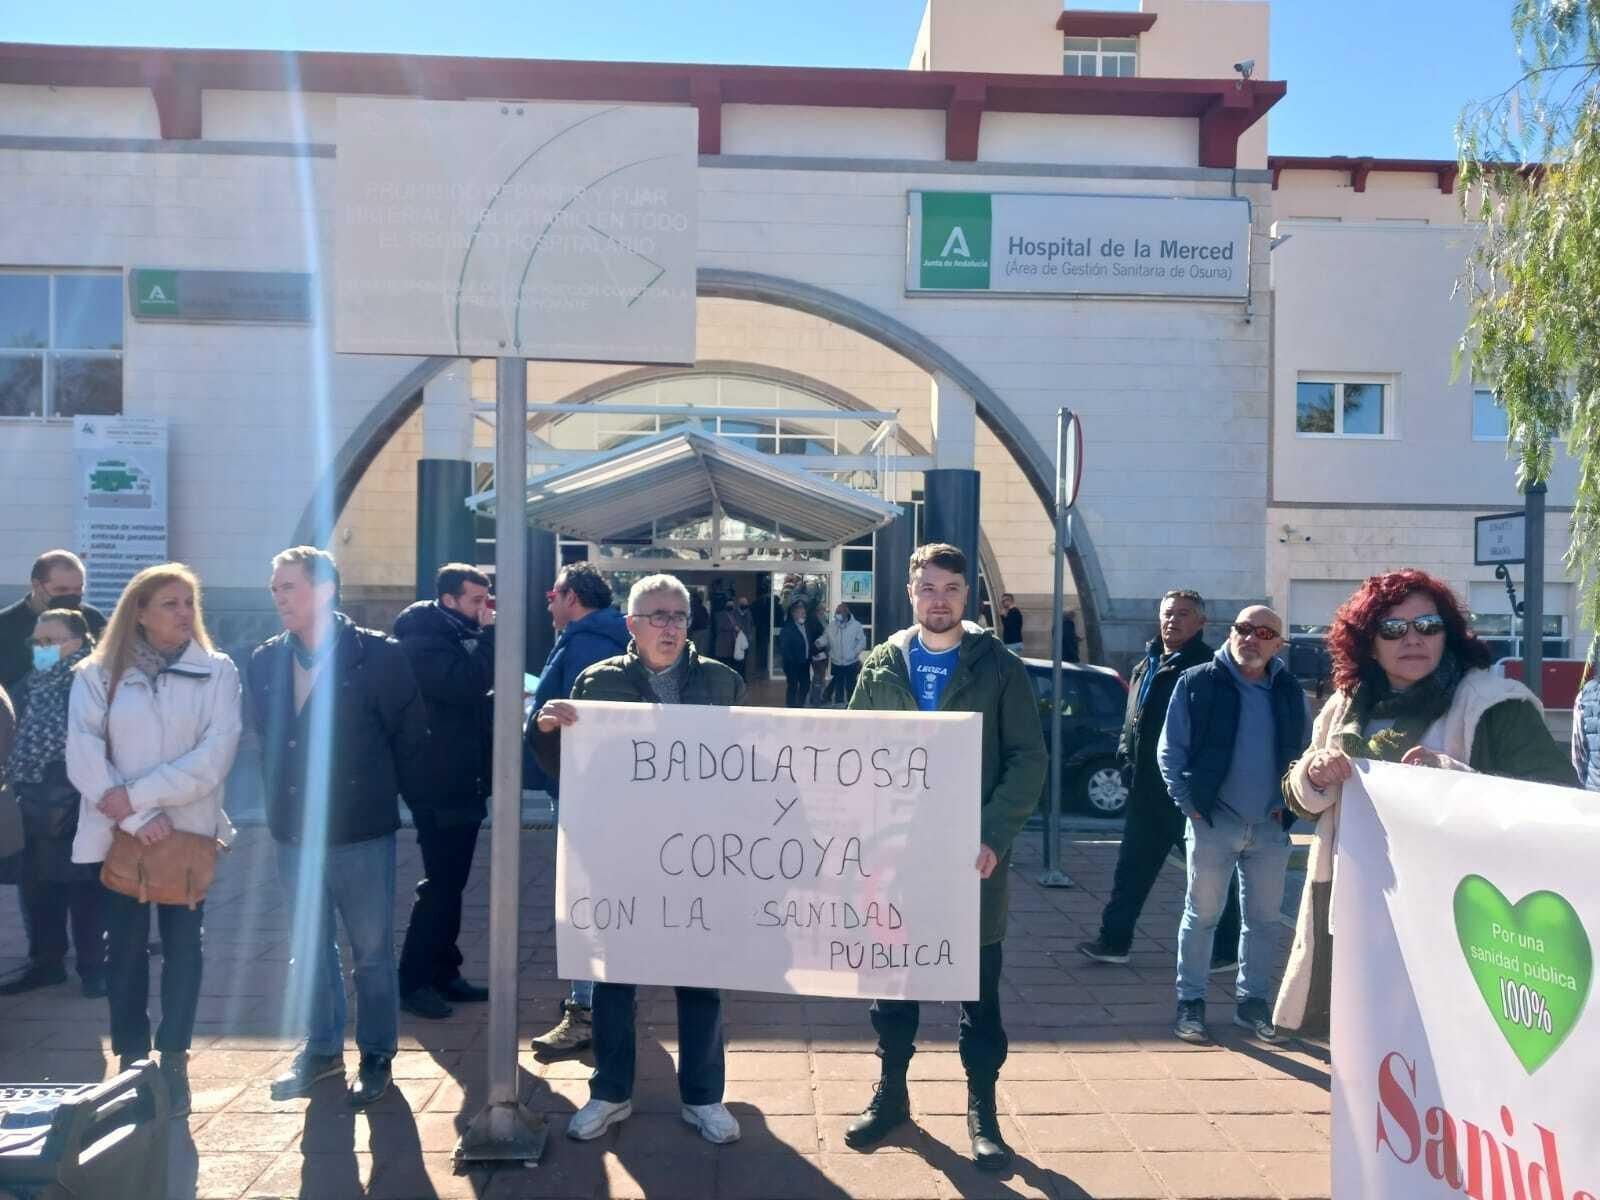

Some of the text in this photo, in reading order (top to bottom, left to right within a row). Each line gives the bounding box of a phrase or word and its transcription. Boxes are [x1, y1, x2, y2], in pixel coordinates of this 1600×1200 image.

[1008, 236, 1234, 261] Hospital de la Merced
[1005, 258, 1233, 281] (Área de Gestión Sanitaria de Osuna)
[629, 739, 931, 790] BADOLATOSA
[772, 797, 798, 827] Y
[658, 832, 871, 881] CORCOYA
[569, 895, 904, 931] CON LA SANIDAD
[829, 938, 955, 971] PÚBLICA
[1491, 922, 1545, 953] Por una
[1469, 944, 1577, 991] sanidad pública
[1498, 976, 1552, 1035] 100%
[1376, 1050, 1600, 1200] Sanid
